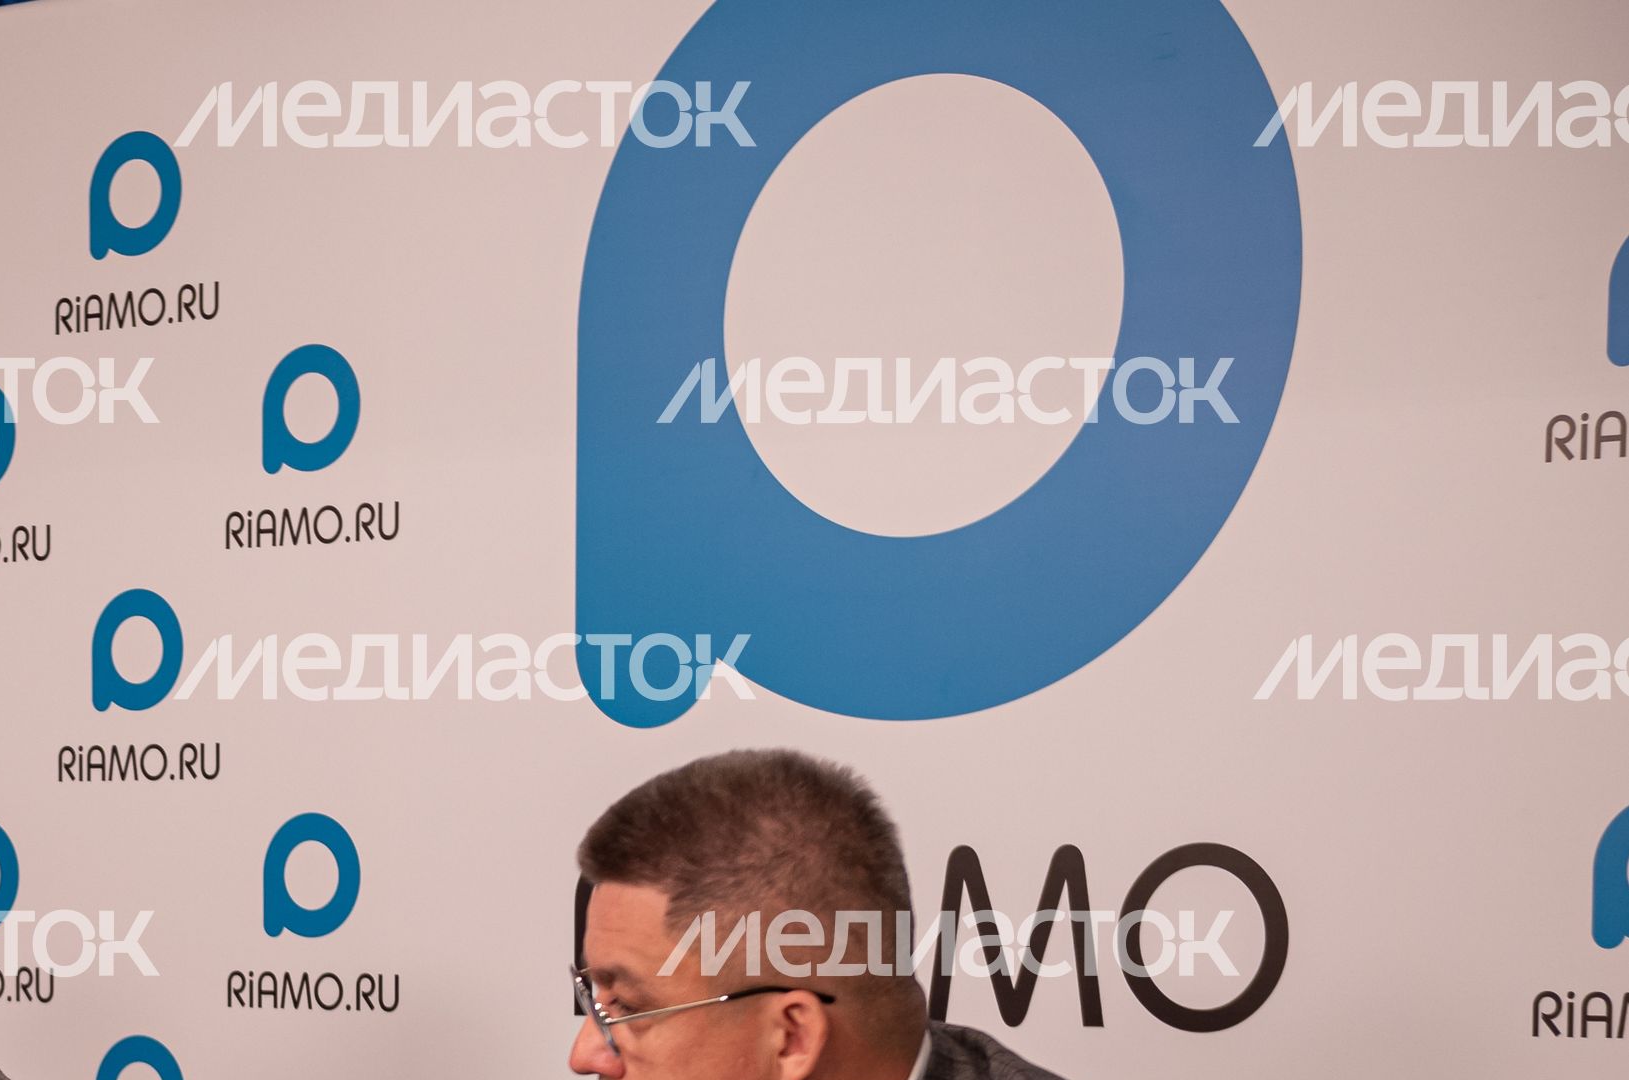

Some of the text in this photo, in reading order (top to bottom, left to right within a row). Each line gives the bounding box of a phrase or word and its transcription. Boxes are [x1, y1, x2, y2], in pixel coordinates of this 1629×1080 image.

[54, 281, 220, 336] RiAMO.RU
[225, 501, 401, 550] RiAMO.RU
[58, 742, 221, 783] RiAMO.RU
[226, 970, 400, 1013] RiAMO.RU
